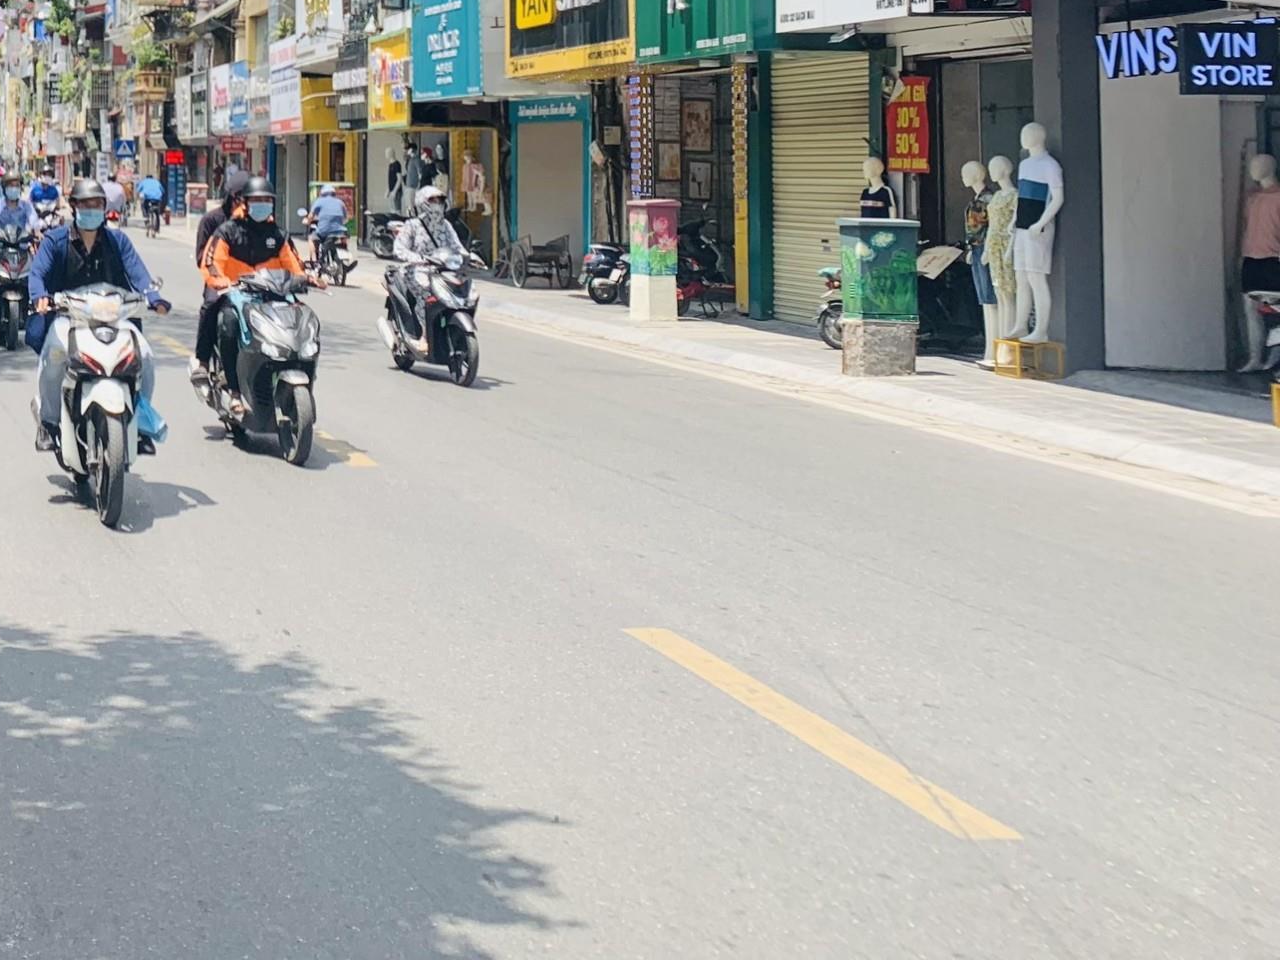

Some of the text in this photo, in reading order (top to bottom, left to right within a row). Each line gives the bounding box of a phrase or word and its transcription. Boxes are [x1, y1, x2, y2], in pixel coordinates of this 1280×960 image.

[1198, 32, 1256, 58] VIN
[1191, 64, 1273, 86] STORE
[895, 133, 919, 154] 50%
